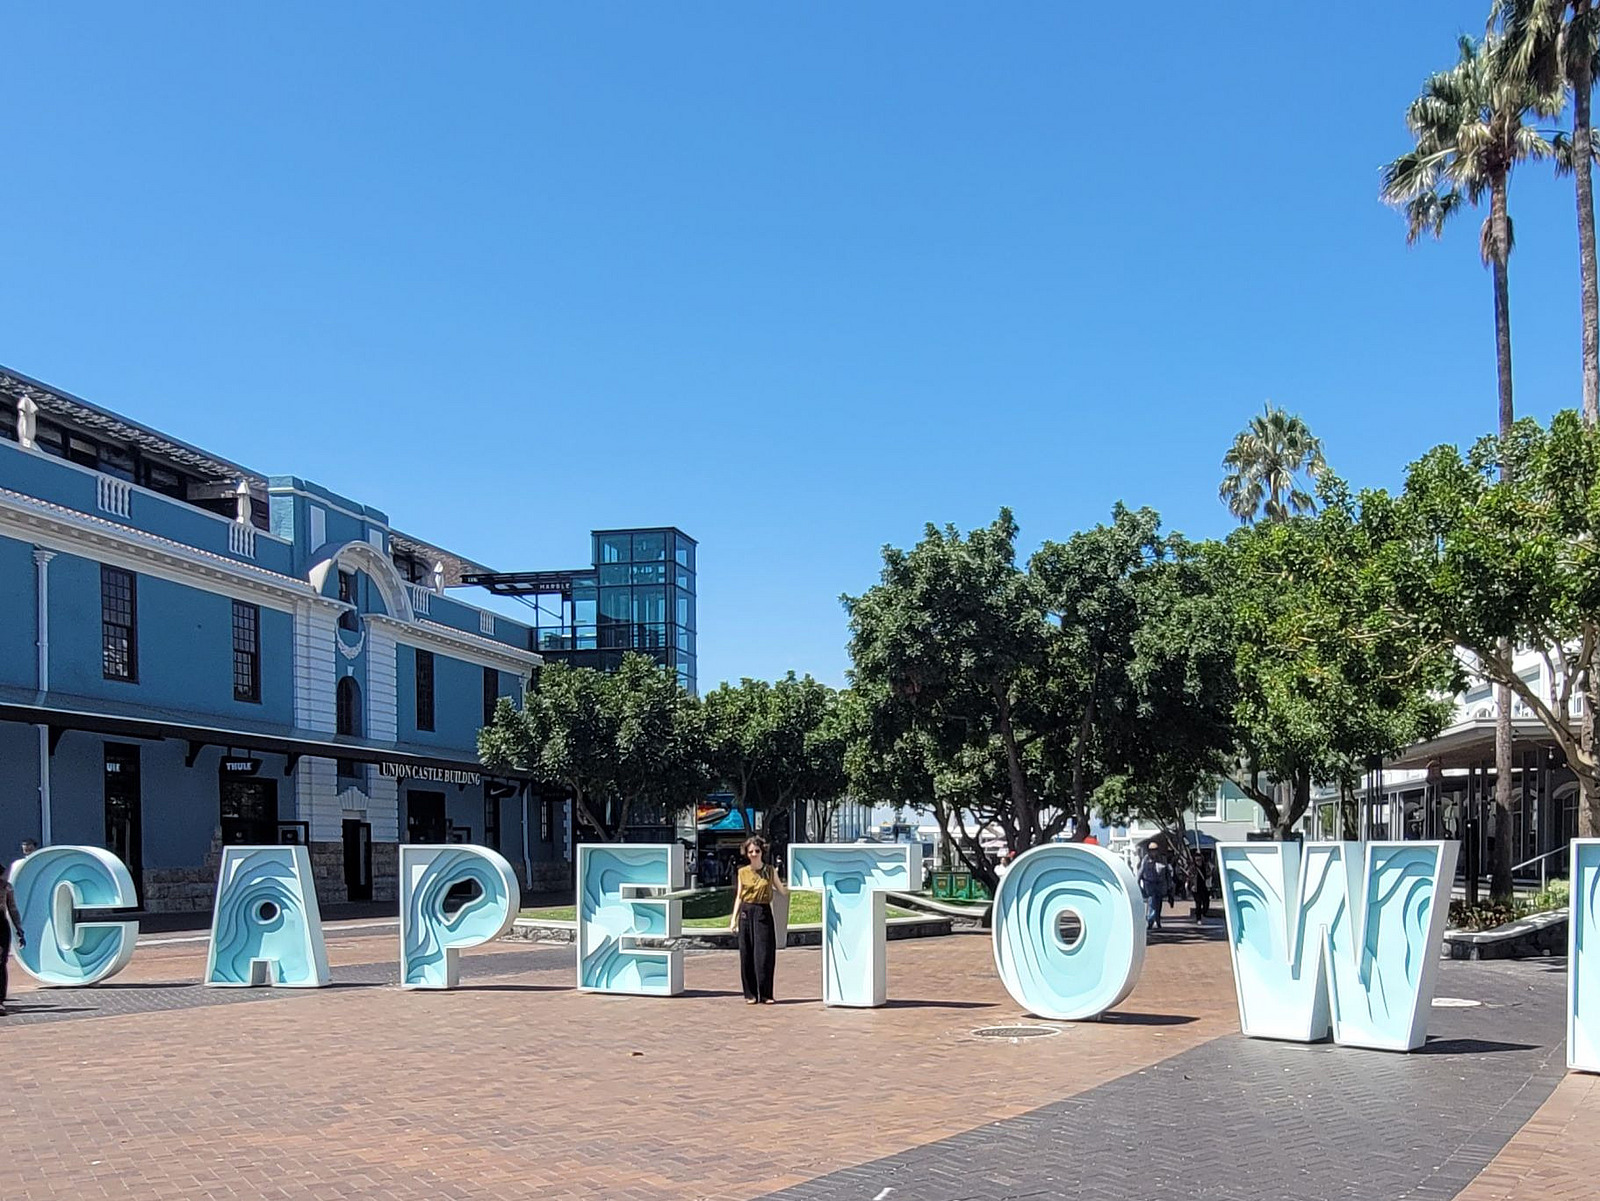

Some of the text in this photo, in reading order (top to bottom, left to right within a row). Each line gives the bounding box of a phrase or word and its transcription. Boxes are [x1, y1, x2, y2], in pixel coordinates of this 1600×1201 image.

[225, 762, 253, 771] THULE
[382, 762, 480, 785] UNION CASTLE BUILDING
